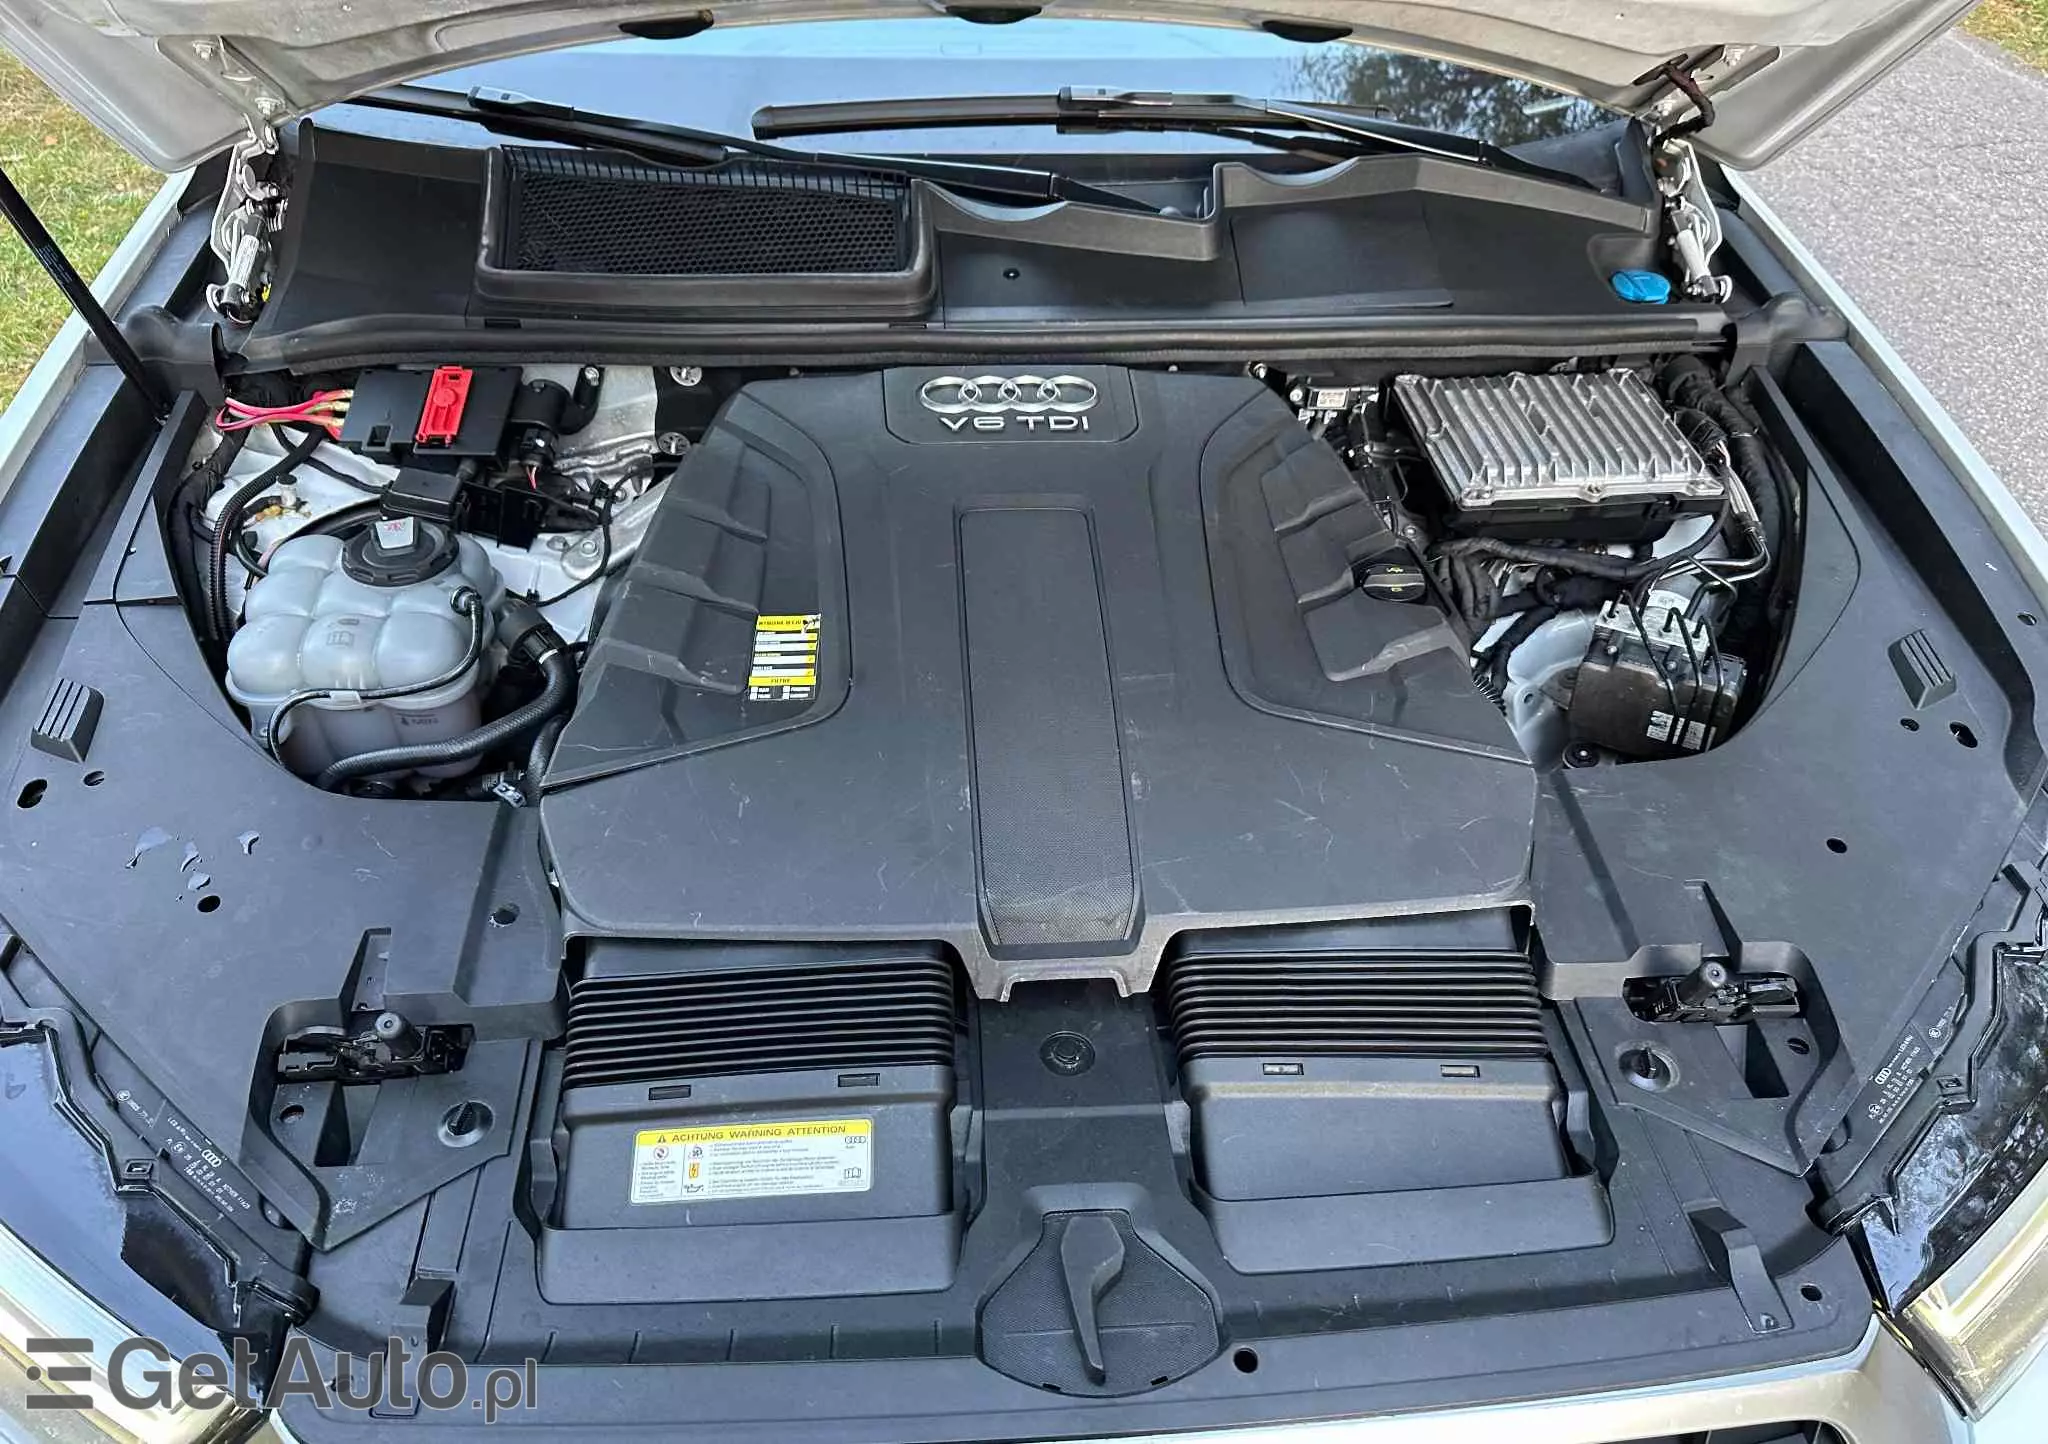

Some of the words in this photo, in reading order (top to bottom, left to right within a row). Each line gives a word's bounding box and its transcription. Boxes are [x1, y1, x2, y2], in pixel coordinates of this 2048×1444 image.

[940, 416, 1004, 431] V6
[1016, 415, 1089, 431] TDI
[671, 1132, 724, 1143] ACHTUNG
[729, 1129, 783, 1139] WARNING
[789, 1125, 846, 1137] ATTENTION
